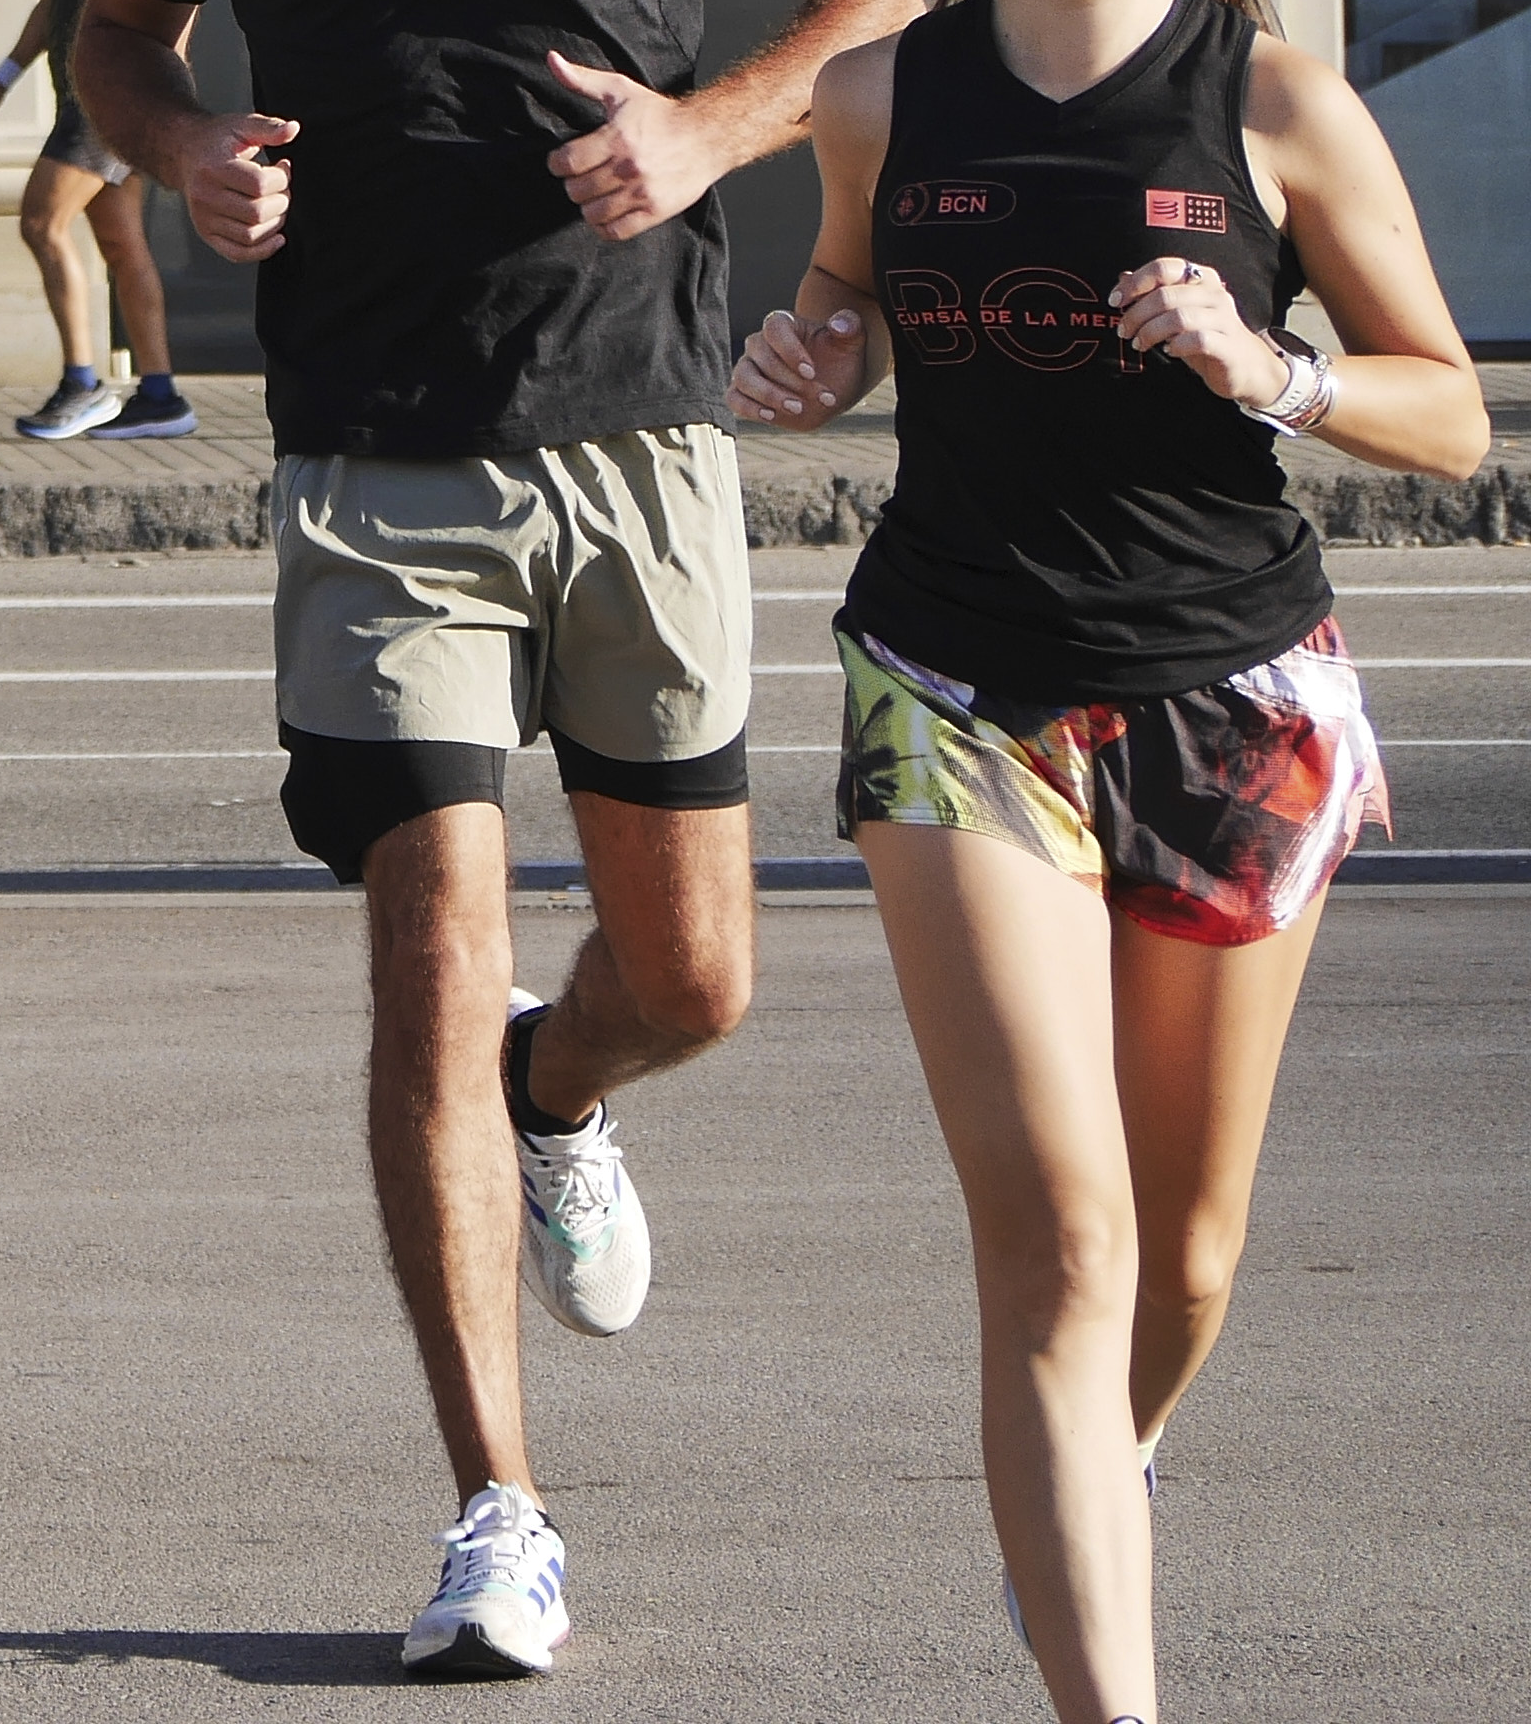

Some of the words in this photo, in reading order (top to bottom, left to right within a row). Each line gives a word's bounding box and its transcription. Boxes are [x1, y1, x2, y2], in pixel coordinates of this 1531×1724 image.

[938, 195, 987, 213] BCN
[896, 309, 968, 326] CURSA
[979, 309, 1013, 325] DE
[1025, 311, 1058, 327] LA
